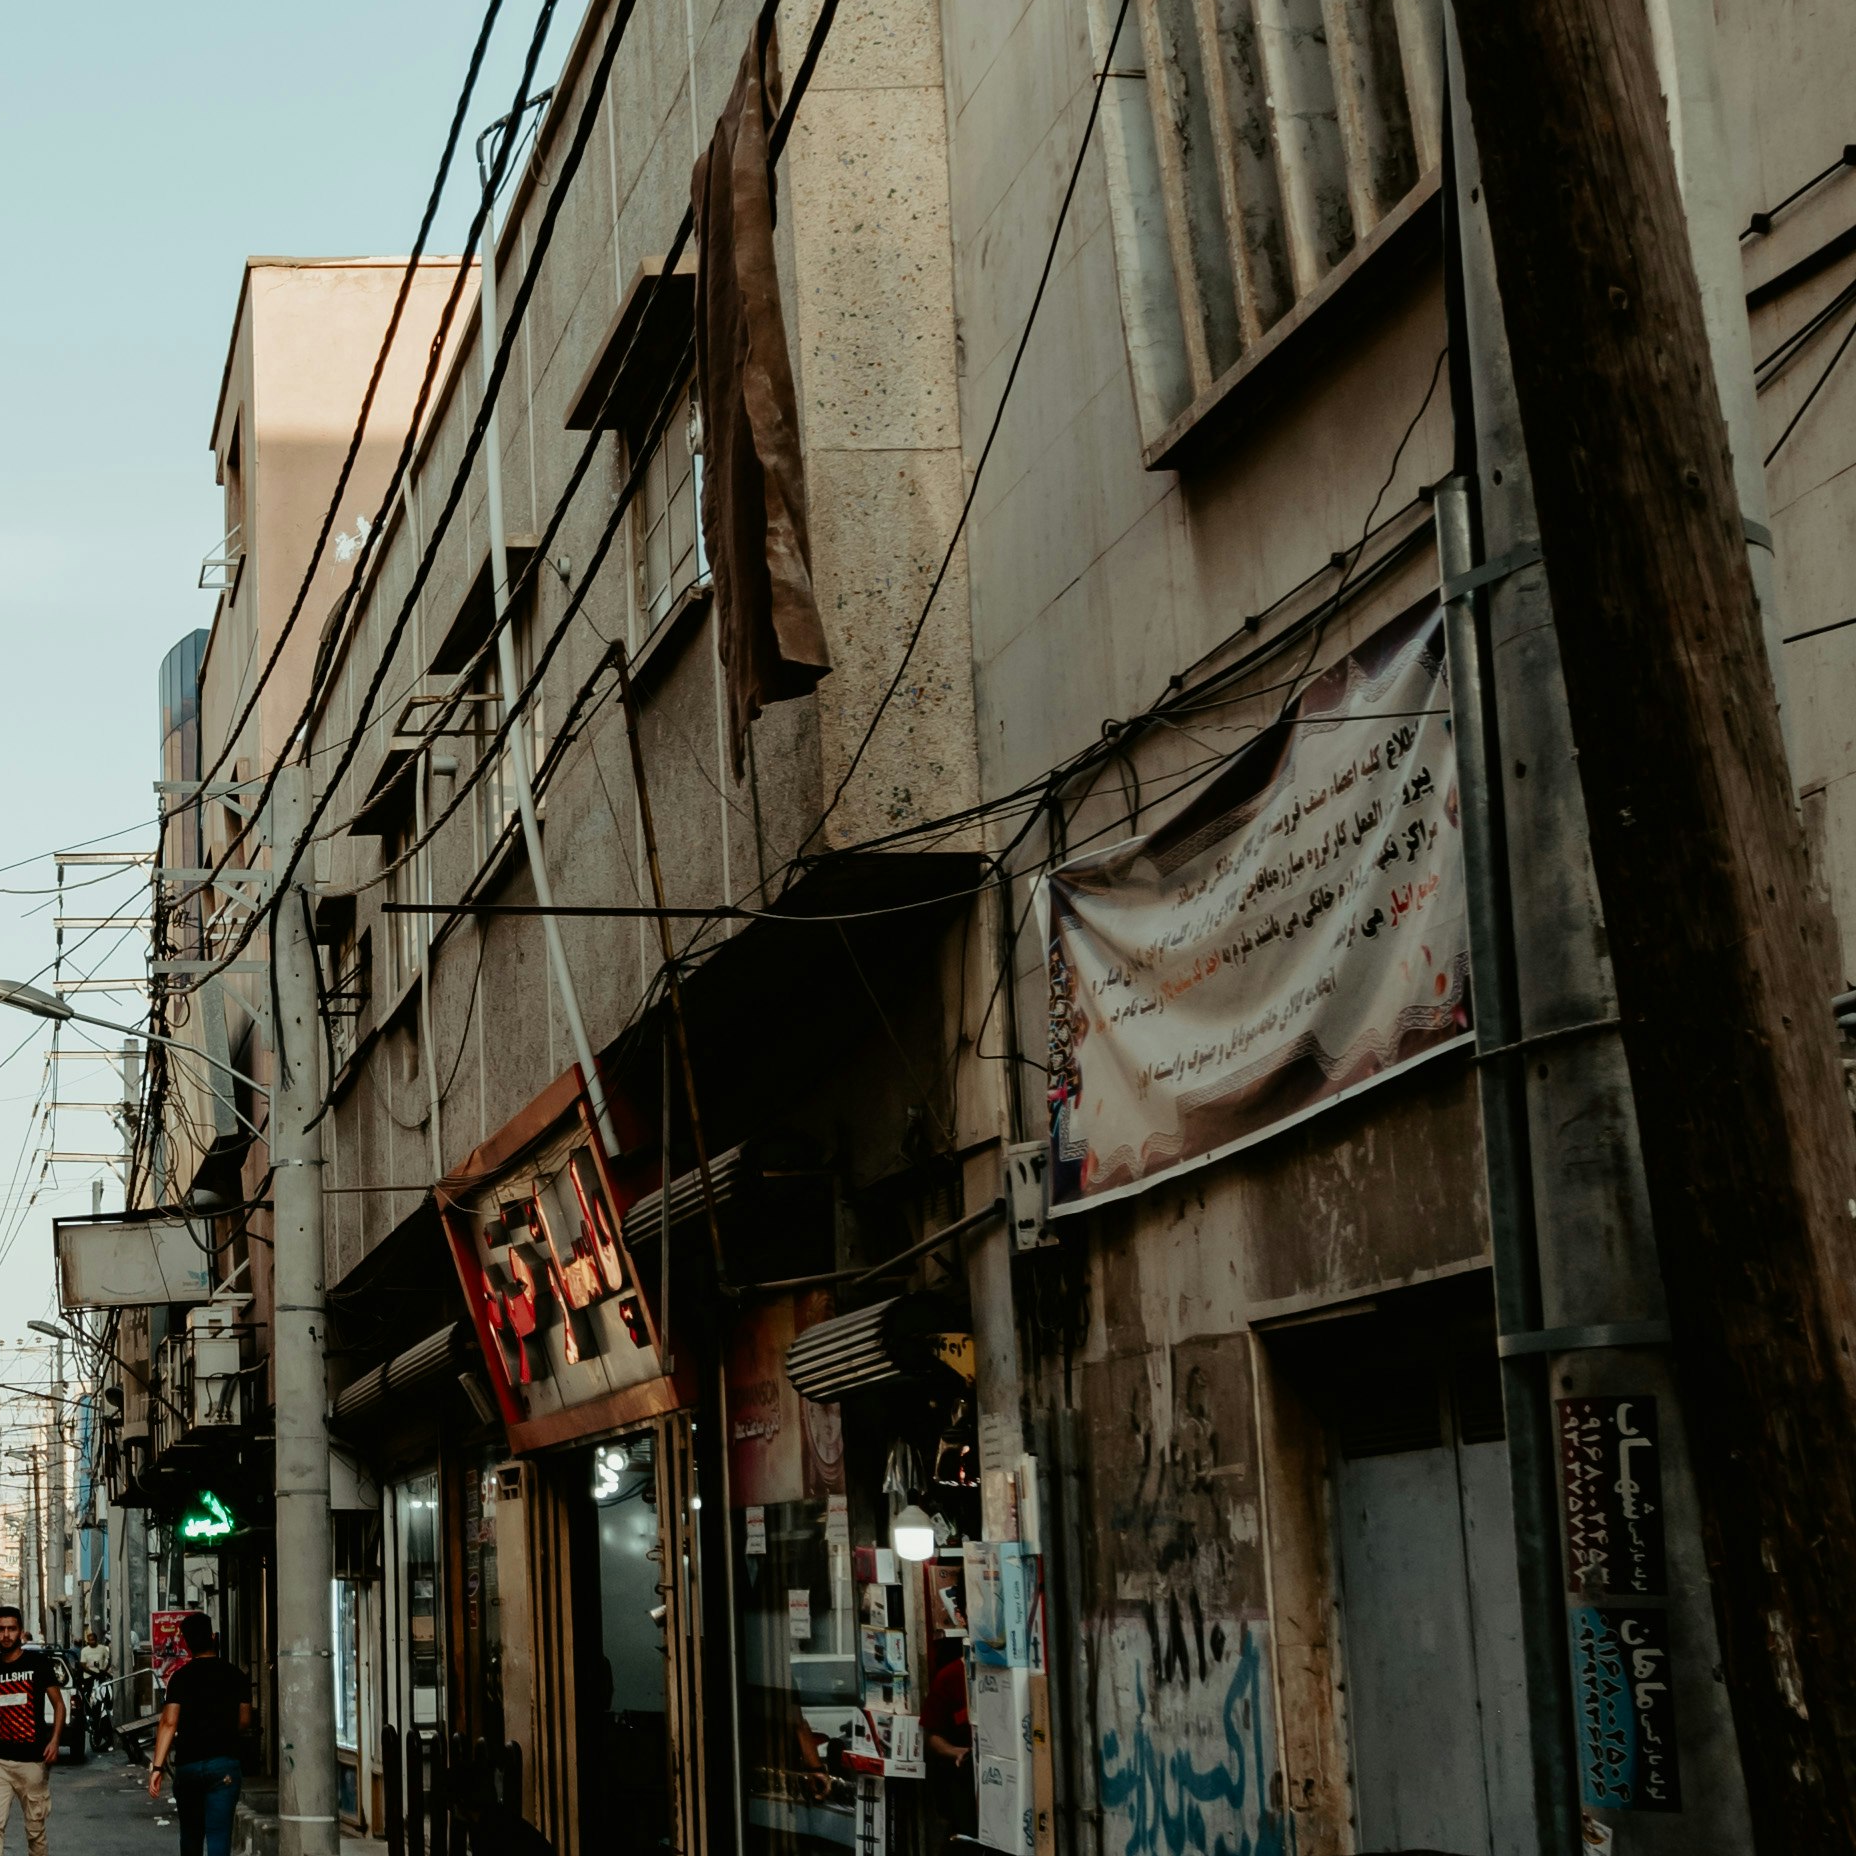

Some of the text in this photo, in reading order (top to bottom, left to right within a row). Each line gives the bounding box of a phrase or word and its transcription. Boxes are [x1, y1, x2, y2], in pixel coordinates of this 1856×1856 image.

[1361, 908, 1384, 938] می
[1608, 1402, 1656, 1521] شهاب
[1621, 1619, 1668, 1710] ماهان
